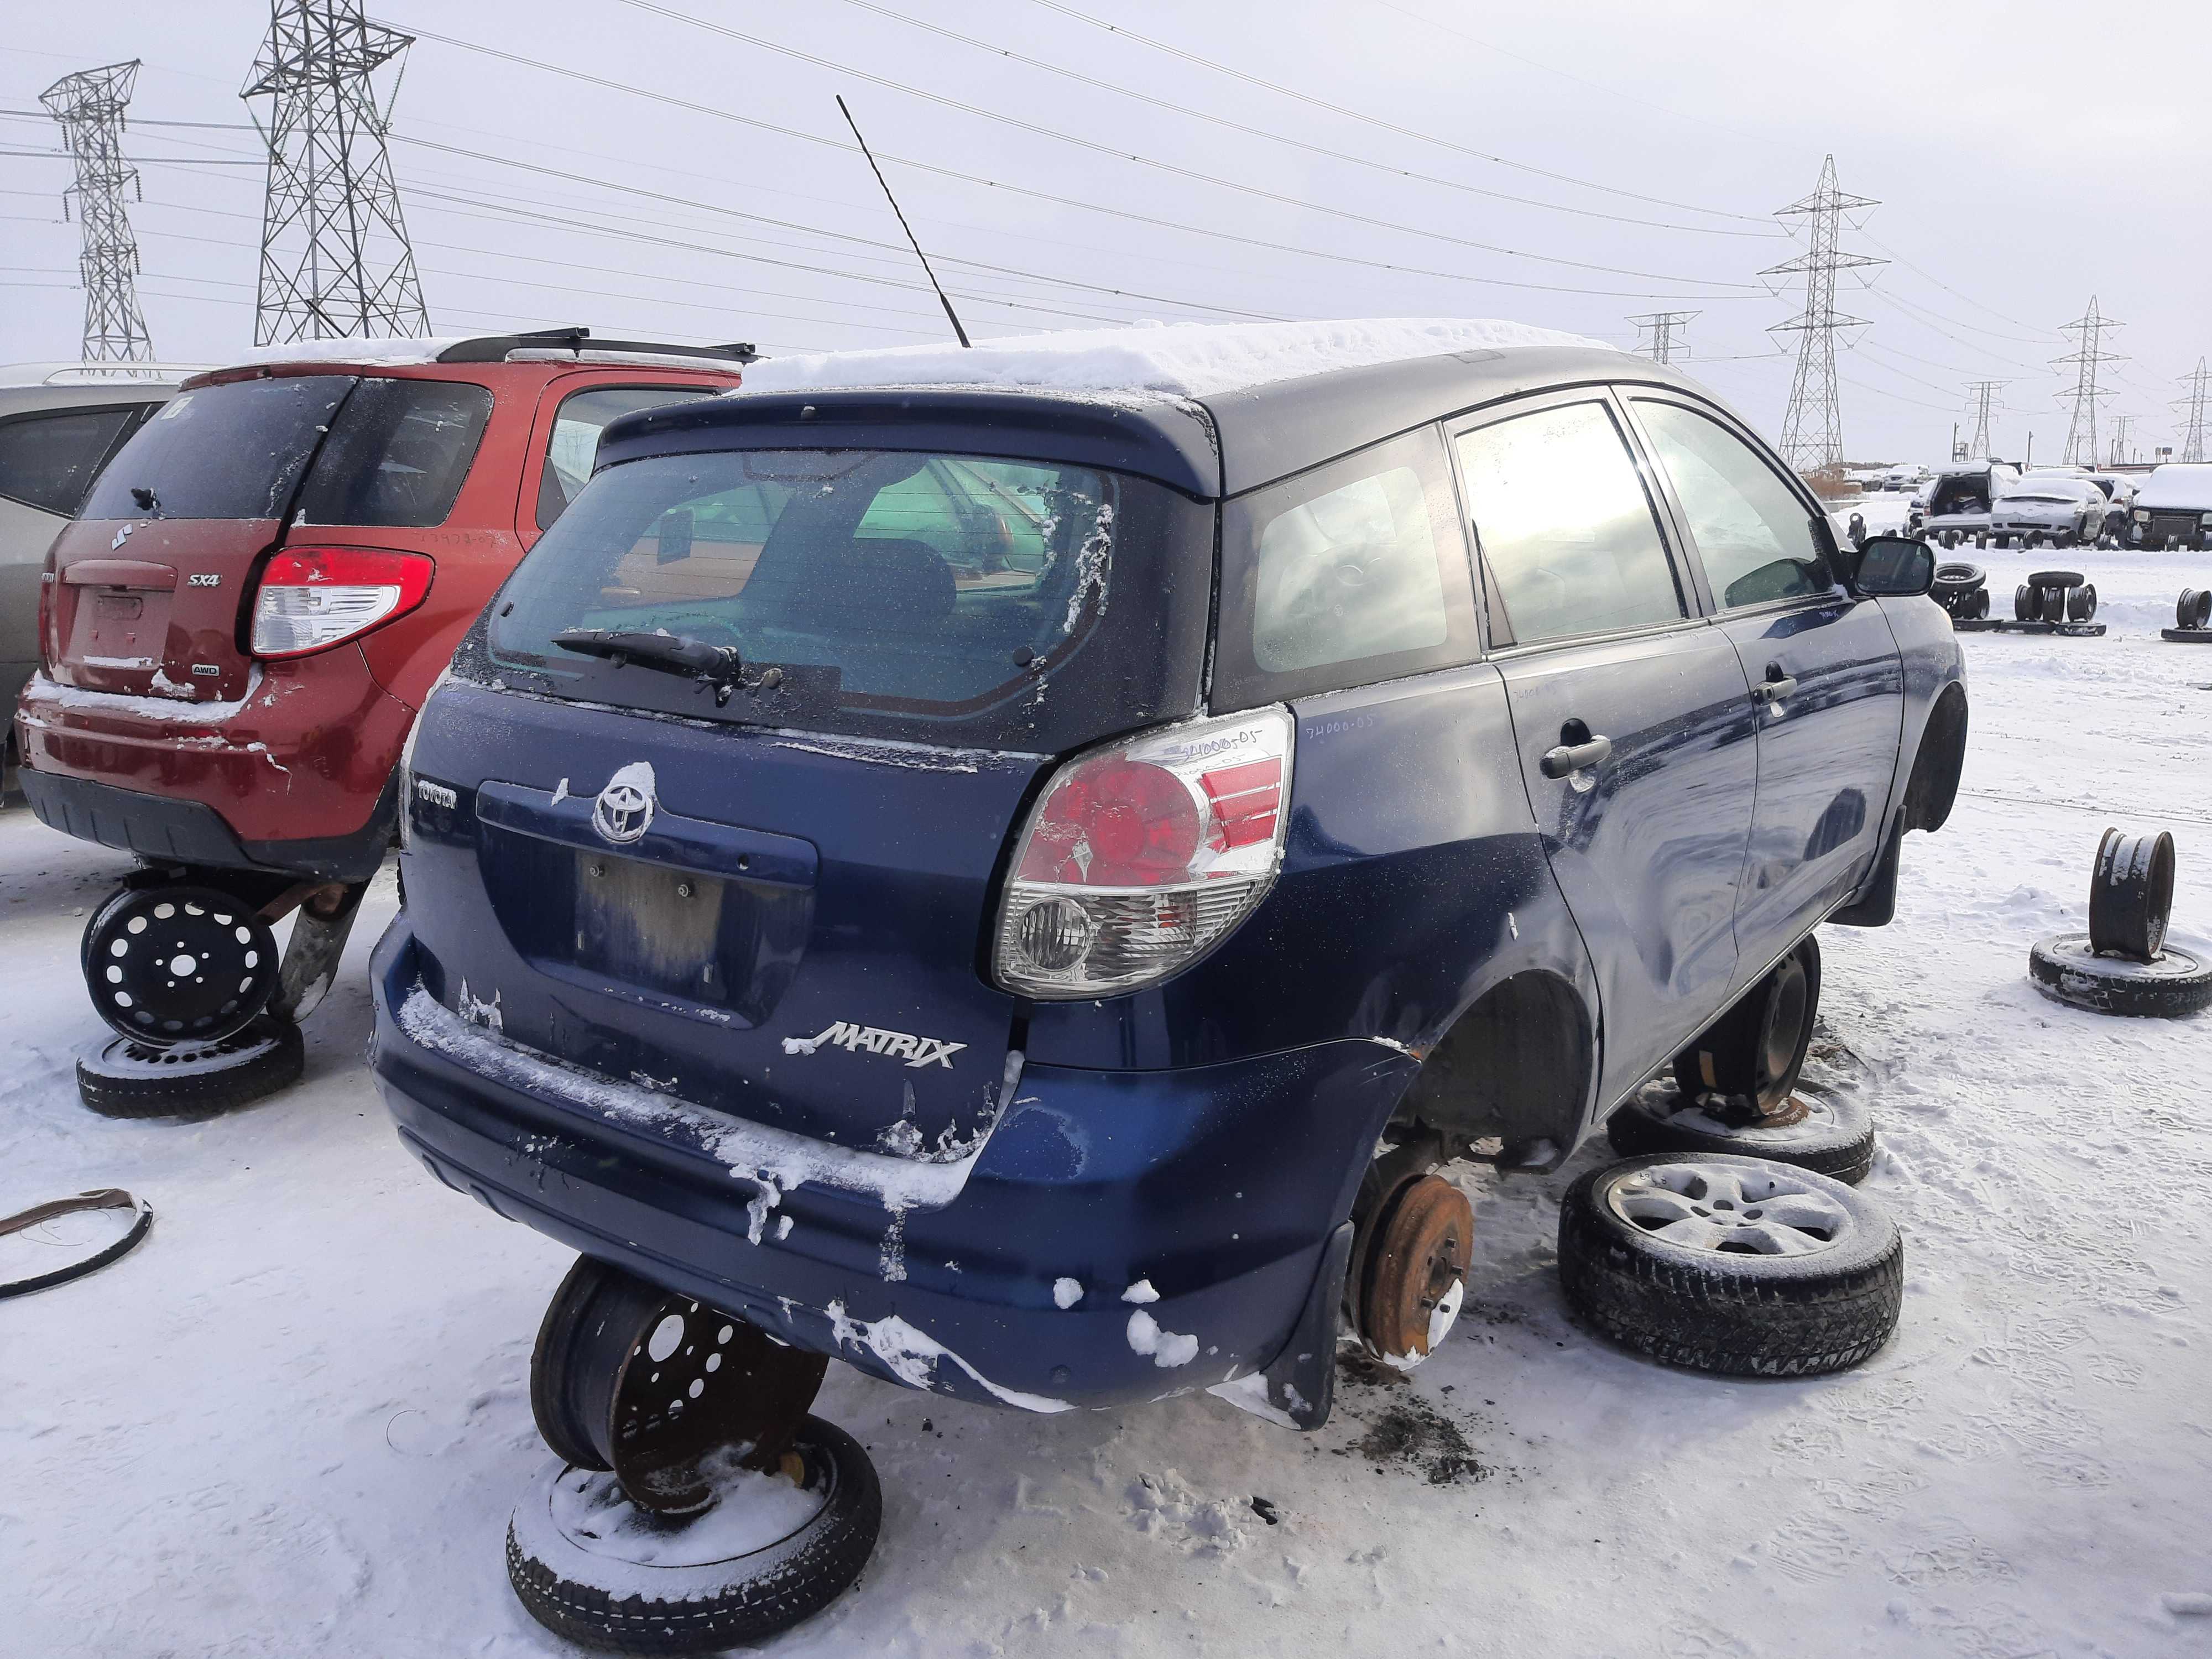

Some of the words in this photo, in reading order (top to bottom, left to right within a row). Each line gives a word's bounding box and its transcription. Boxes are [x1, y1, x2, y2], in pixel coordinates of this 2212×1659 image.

[187, 575, 221, 587] SX4
[194, 666, 217, 675] AWD
[418, 780, 457, 810] TOYOTA
[811, 1020, 968, 1070] MATRIX
